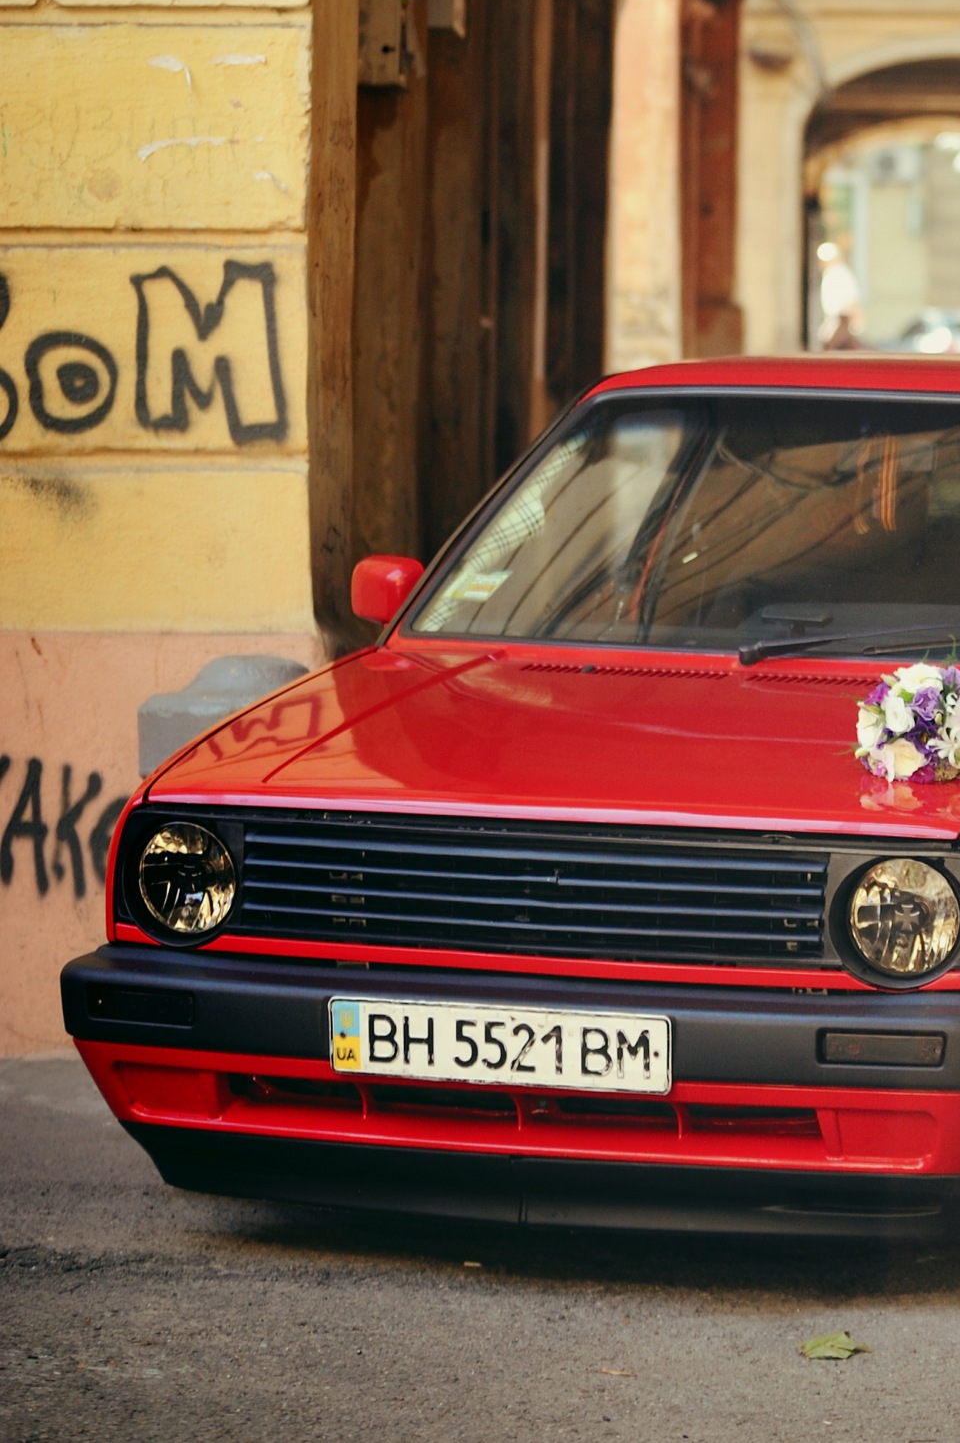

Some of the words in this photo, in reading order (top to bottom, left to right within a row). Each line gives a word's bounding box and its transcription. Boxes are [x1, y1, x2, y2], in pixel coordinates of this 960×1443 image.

[336, 1046, 358, 1062] UA
[367, 1013, 435, 1066] BH
[452, 1019, 563, 1075] 5521
[580, 1026, 651, 1079] BM
